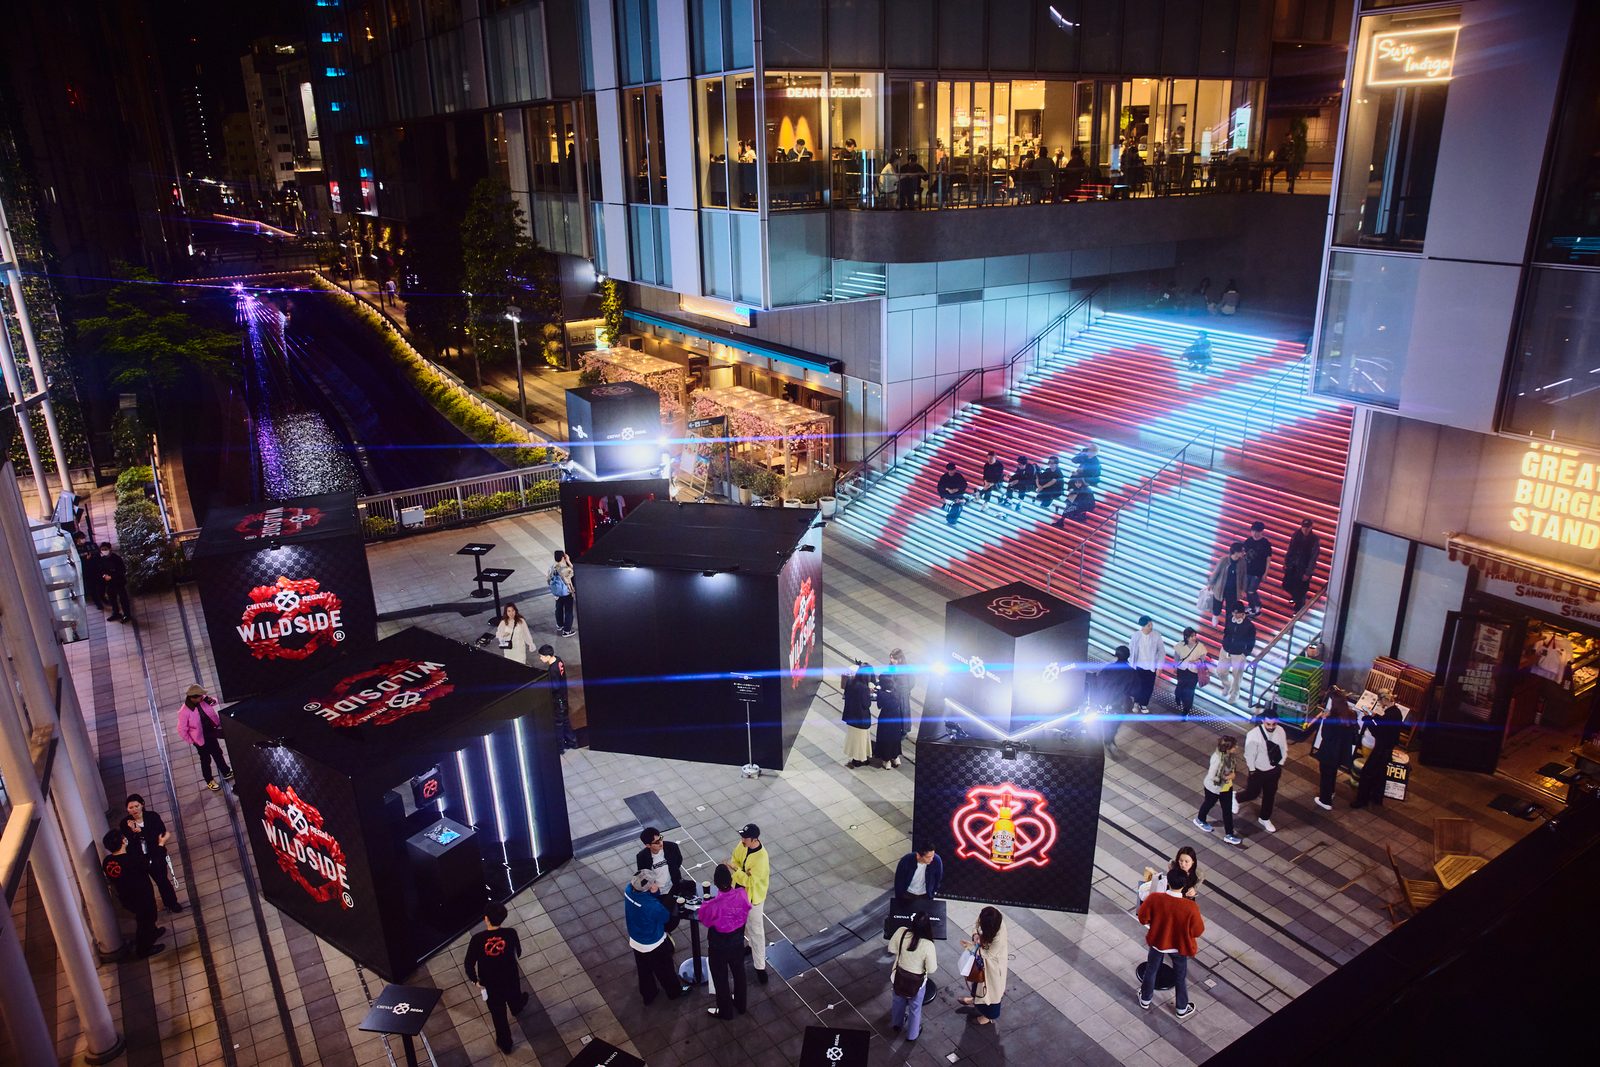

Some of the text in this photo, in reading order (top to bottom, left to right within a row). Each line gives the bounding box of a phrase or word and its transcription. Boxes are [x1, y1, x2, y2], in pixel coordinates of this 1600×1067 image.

[1404, 56, 1450, 77] Indigo
[786, 87, 873, 98] DEAN & DELUCA
[1510, 506, 1600, 550] STAND
[246, 593, 325, 610] CHIVAS REGAL
[236, 610, 343, 643] WILDSIDE
[315, 661, 446, 721] WILDSIDE
[261, 819, 351, 890] WILDSIDE
